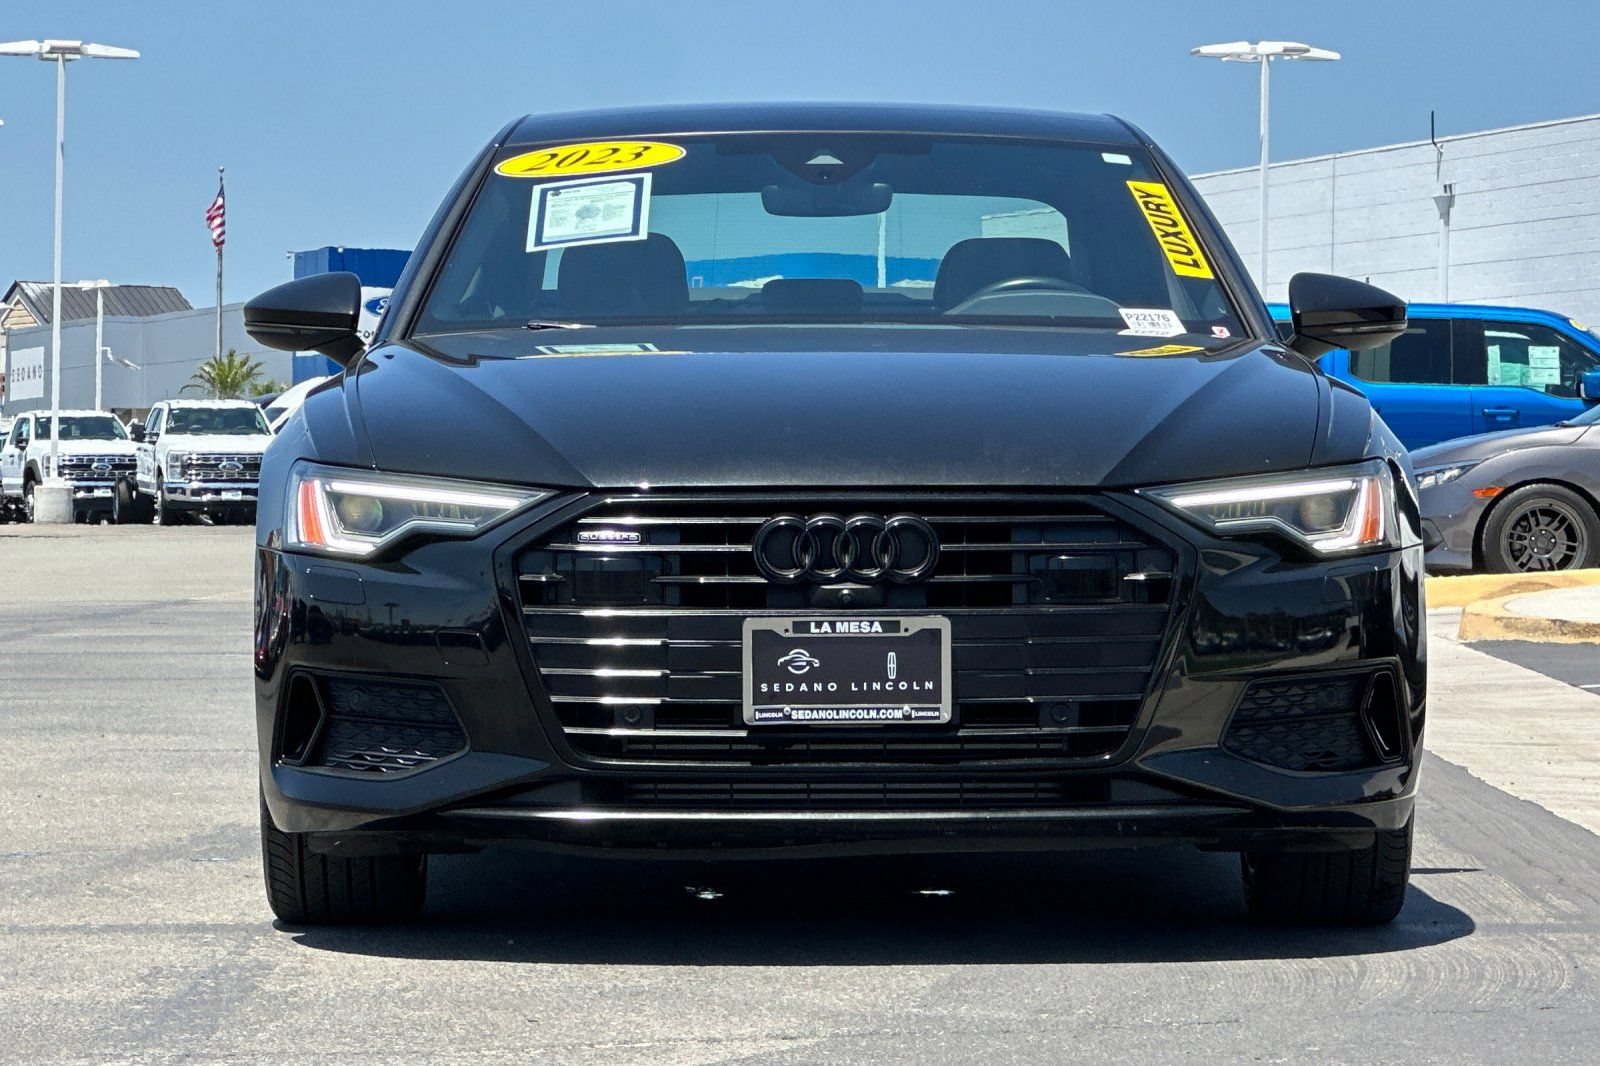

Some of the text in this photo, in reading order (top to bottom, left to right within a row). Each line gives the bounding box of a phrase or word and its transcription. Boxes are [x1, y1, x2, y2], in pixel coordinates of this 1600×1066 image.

[520, 145, 652, 172] 2023
[1133, 185, 1202, 270] LUXURY
[1125, 312, 1171, 322] P22176
[12, 364, 42, 383] SEDANO
[810, 621, 883, 634] LA MESA
[761, 681, 934, 692] SEDANO LINCOLN
[791, 709, 903, 720] SEDANOLINCOLN.COM
